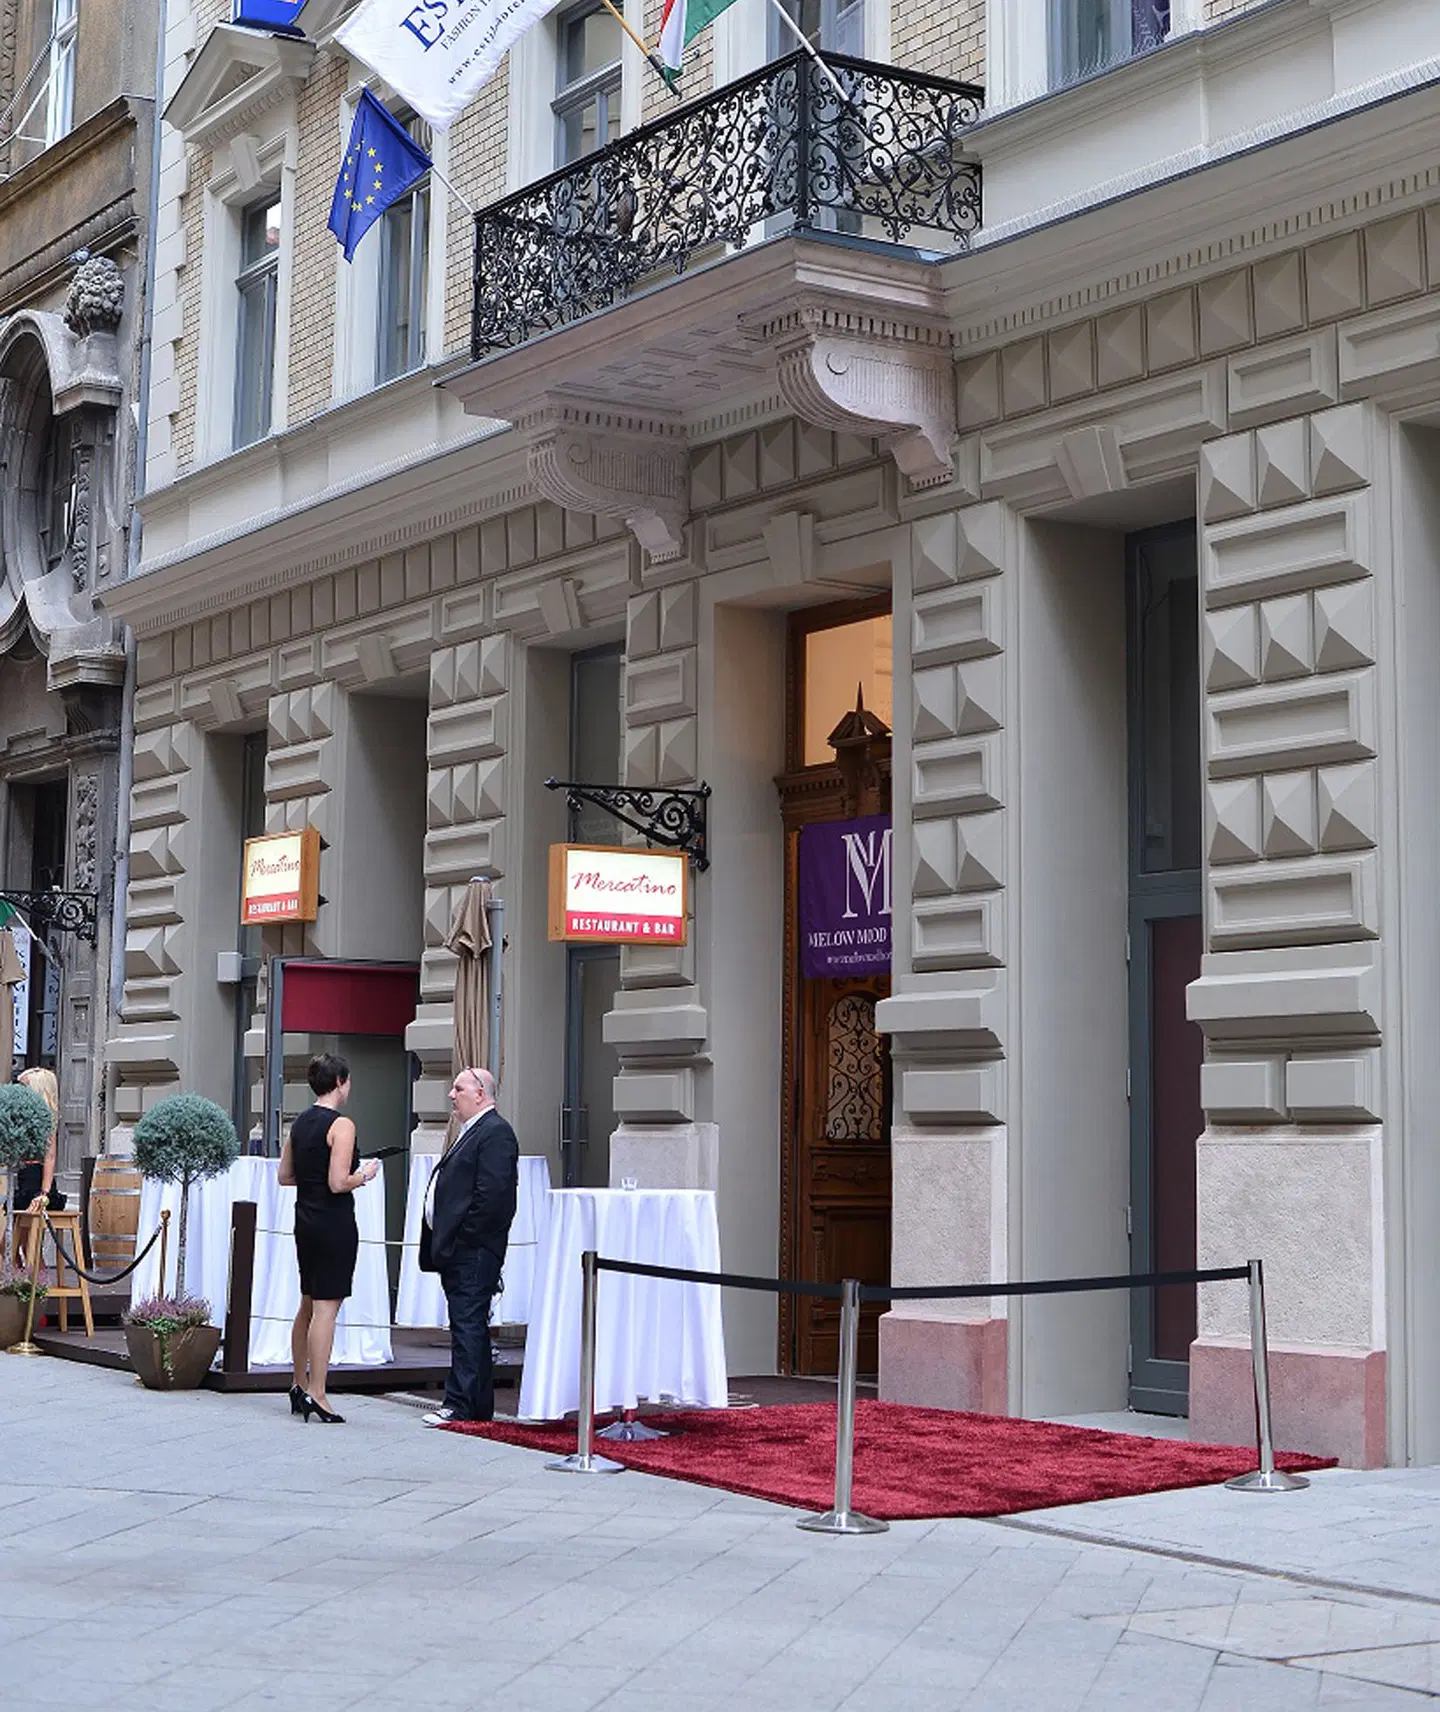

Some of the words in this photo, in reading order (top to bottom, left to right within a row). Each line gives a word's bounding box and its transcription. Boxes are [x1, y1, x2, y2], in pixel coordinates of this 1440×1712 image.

[399, 0, 465, 52] ES
[440, 5, 481, 50] FASHION
[251, 854, 300, 877] Mercatino
[571, 871, 676, 896] Mercatino
[572, 918, 640, 933] RESTAURANT
[642, 922, 651, 934] &
[654, 922, 675, 935] BAR
